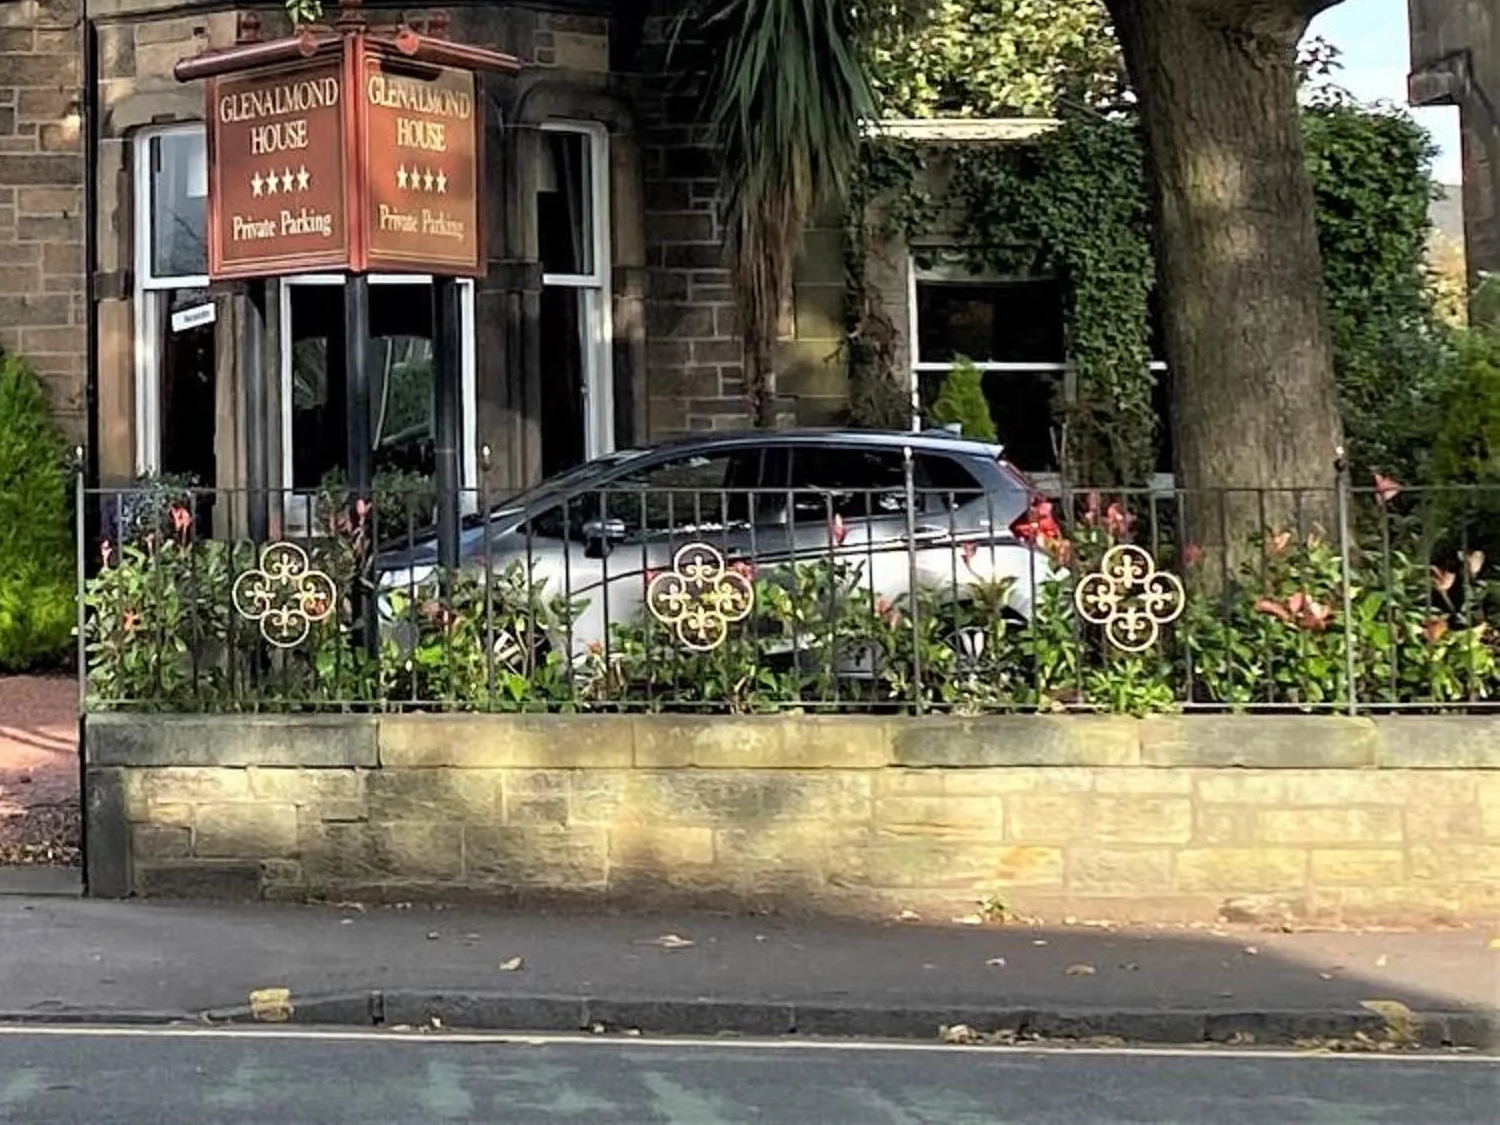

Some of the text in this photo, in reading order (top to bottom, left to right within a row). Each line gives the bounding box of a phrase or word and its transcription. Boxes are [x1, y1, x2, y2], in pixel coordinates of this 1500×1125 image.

[220, 77, 339, 123] GLENALMOND
[368, 75, 470, 119] GLENALMOND
[251, 120, 309, 155] HOUSE
[397, 118, 447, 152] HOUSE
[233, 208, 333, 241] Private Parking
[379, 204, 464, 241] Private Parking
